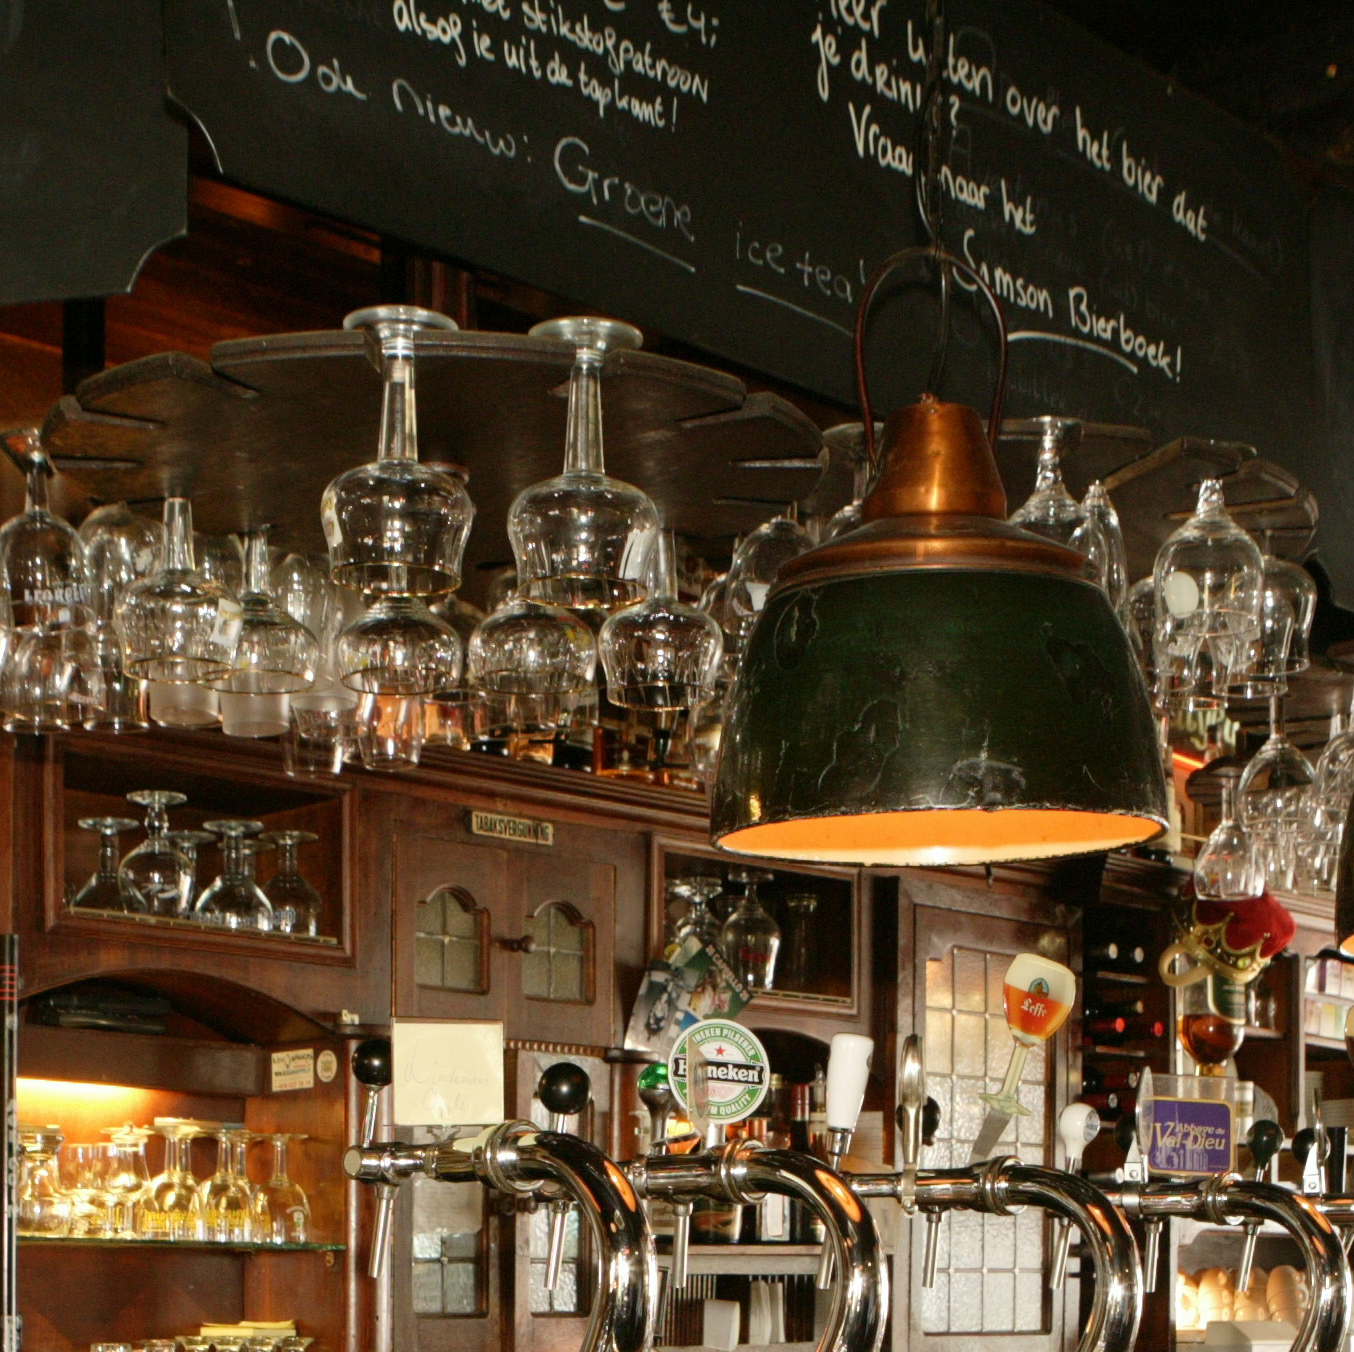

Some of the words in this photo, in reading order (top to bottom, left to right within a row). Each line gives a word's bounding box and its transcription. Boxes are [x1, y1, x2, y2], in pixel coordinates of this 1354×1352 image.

[503, 36, 542, 79] uit
[547, 52, 574, 87] de
[1006, 85, 1060, 134] over
[1075, 105, 1112, 172] het
[1122, 142, 1164, 205] bier
[1172, 192, 1207, 241] dat
[553, 137, 697, 243] Groene
[735, 220, 785, 274] ice
[940, 164, 991, 212] naar
[1001, 178, 1037, 235] het
[1021, 997, 1048, 1018] Leffe
[719, 1093, 752, 1116] QUALITY
[1154, 1121, 1226, 1151] Val-Dieu
